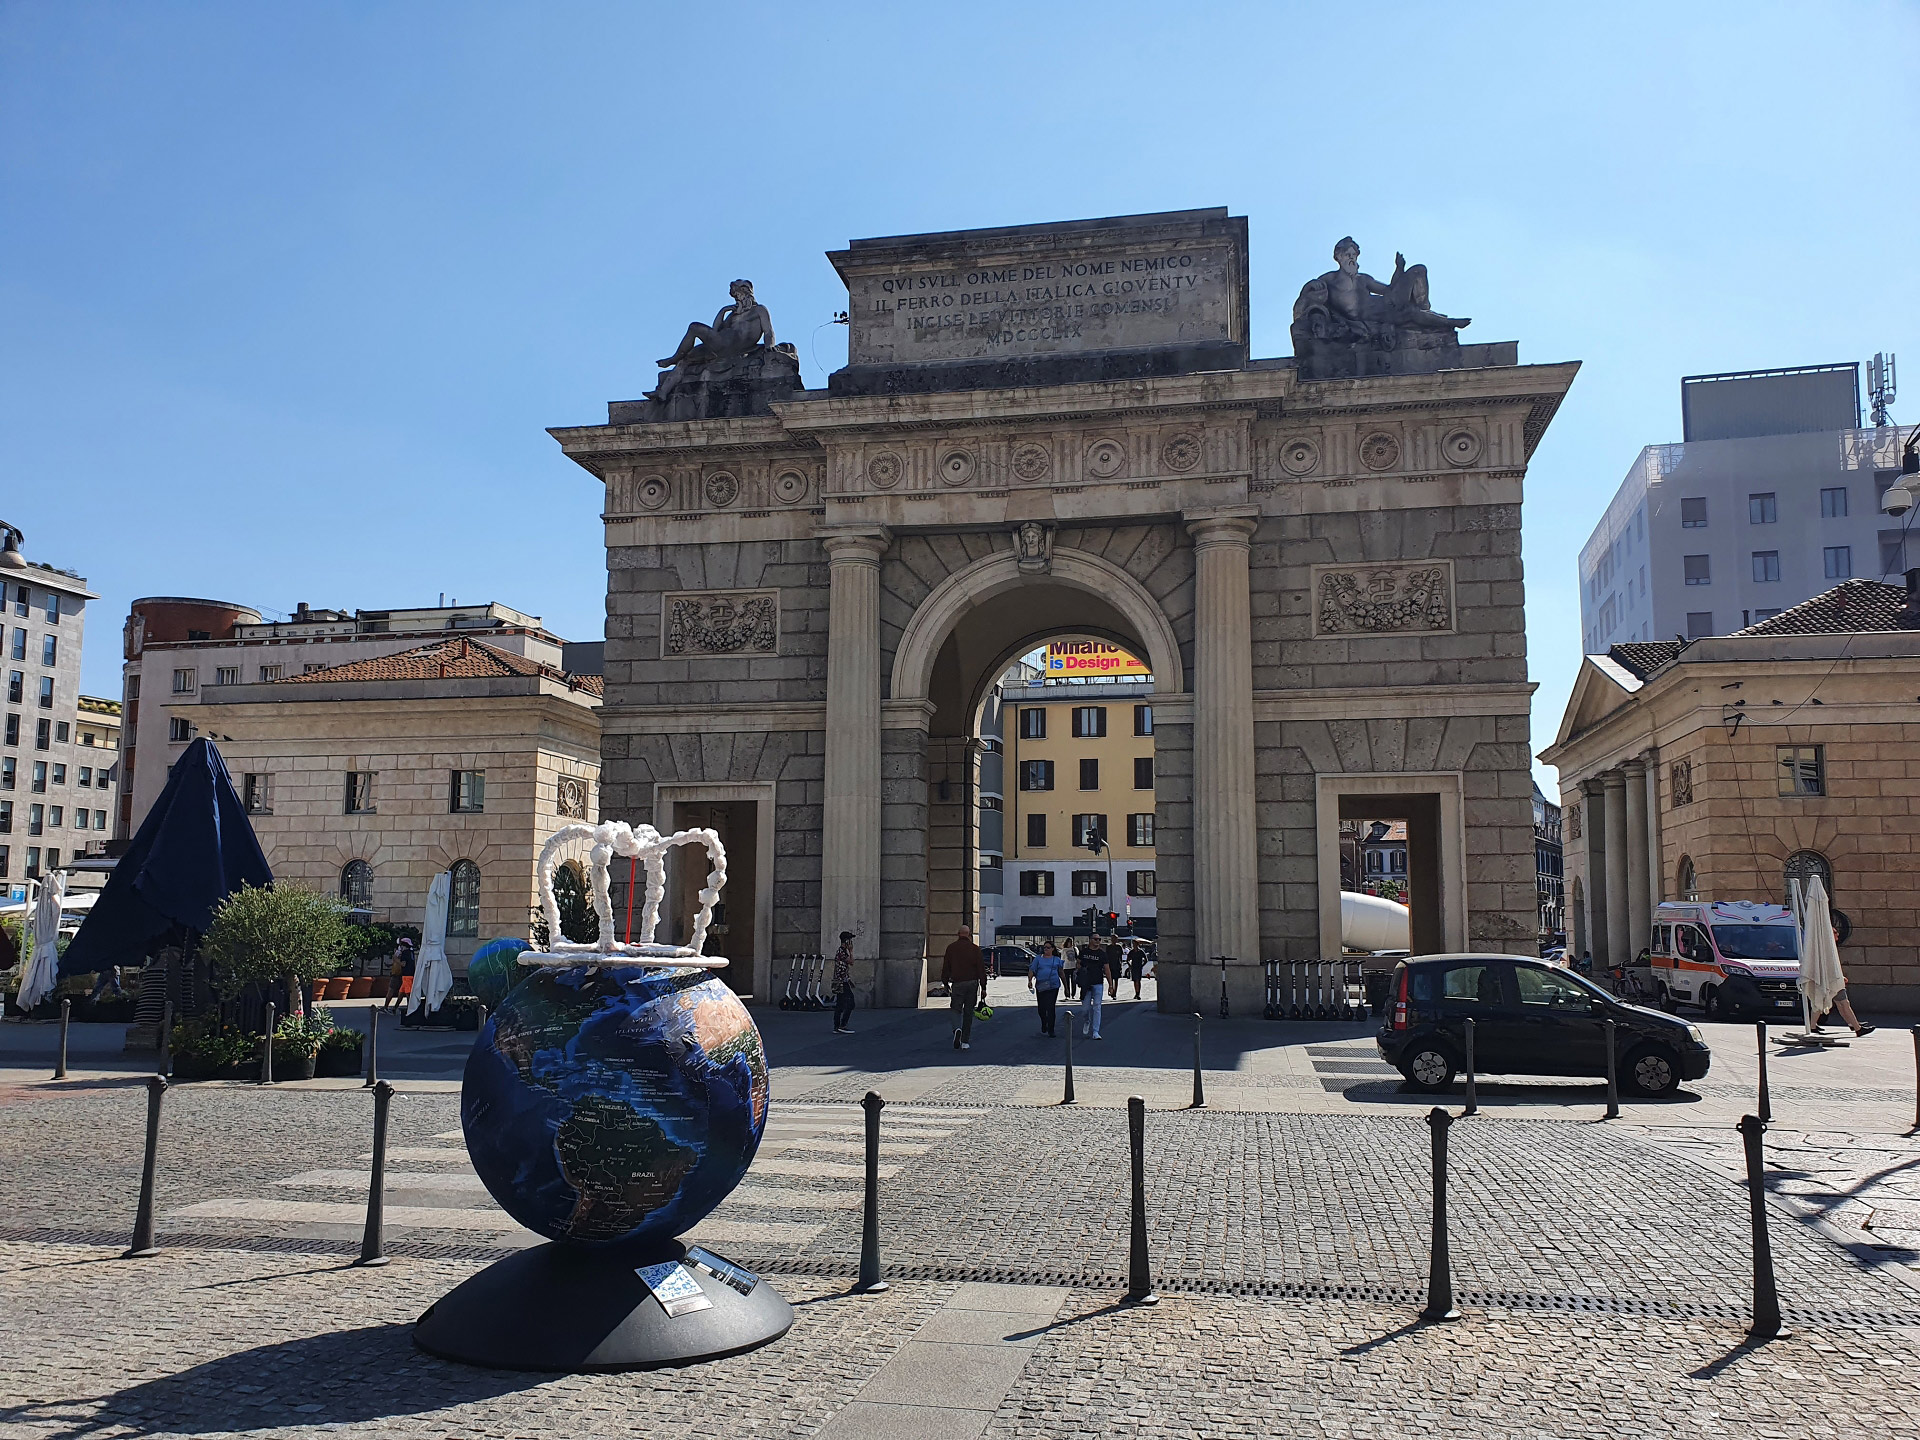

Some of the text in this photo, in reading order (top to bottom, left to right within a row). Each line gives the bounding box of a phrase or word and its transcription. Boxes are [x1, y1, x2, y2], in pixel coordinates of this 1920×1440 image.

[882, 255, 1192, 293] QVI SVLL ORME DEL NOME NEMICO
[876, 274, 1198, 311] IL FERRO DELLA ITALICA GIOVENTV
[907, 297, 1170, 329] INCISE LE VITTORIE COMENSI
[986, 323, 1083, 344] MDCCCLIX
[1049, 656, 1064, 669] is
[1066, 655, 1120, 671] Design
